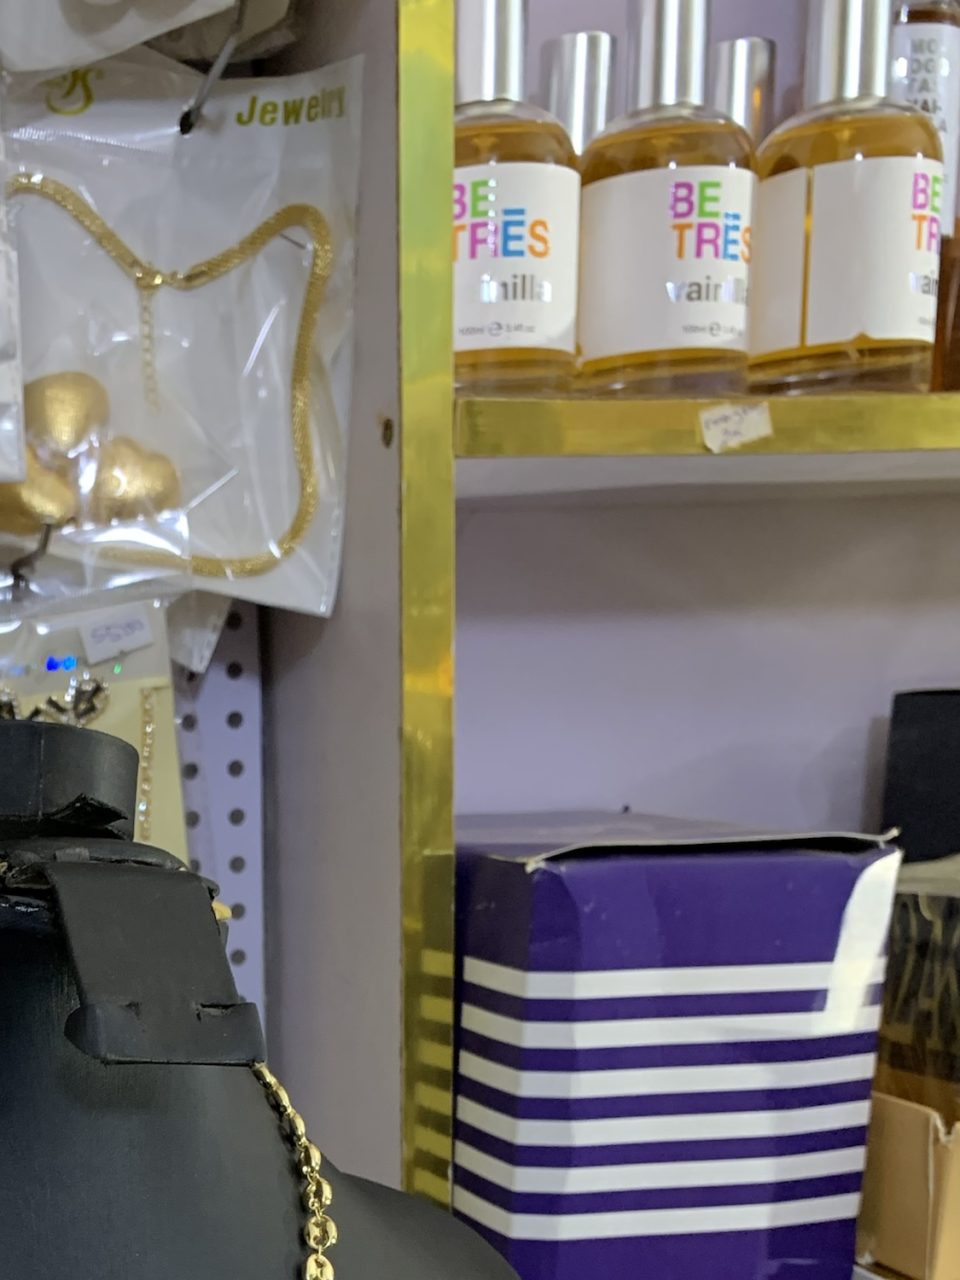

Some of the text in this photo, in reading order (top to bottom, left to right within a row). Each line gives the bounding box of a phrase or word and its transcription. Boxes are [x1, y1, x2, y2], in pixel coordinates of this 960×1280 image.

[453, 179, 494, 220] BE
[671, 181, 721, 219] BE
[912, 173, 941, 213] BE
